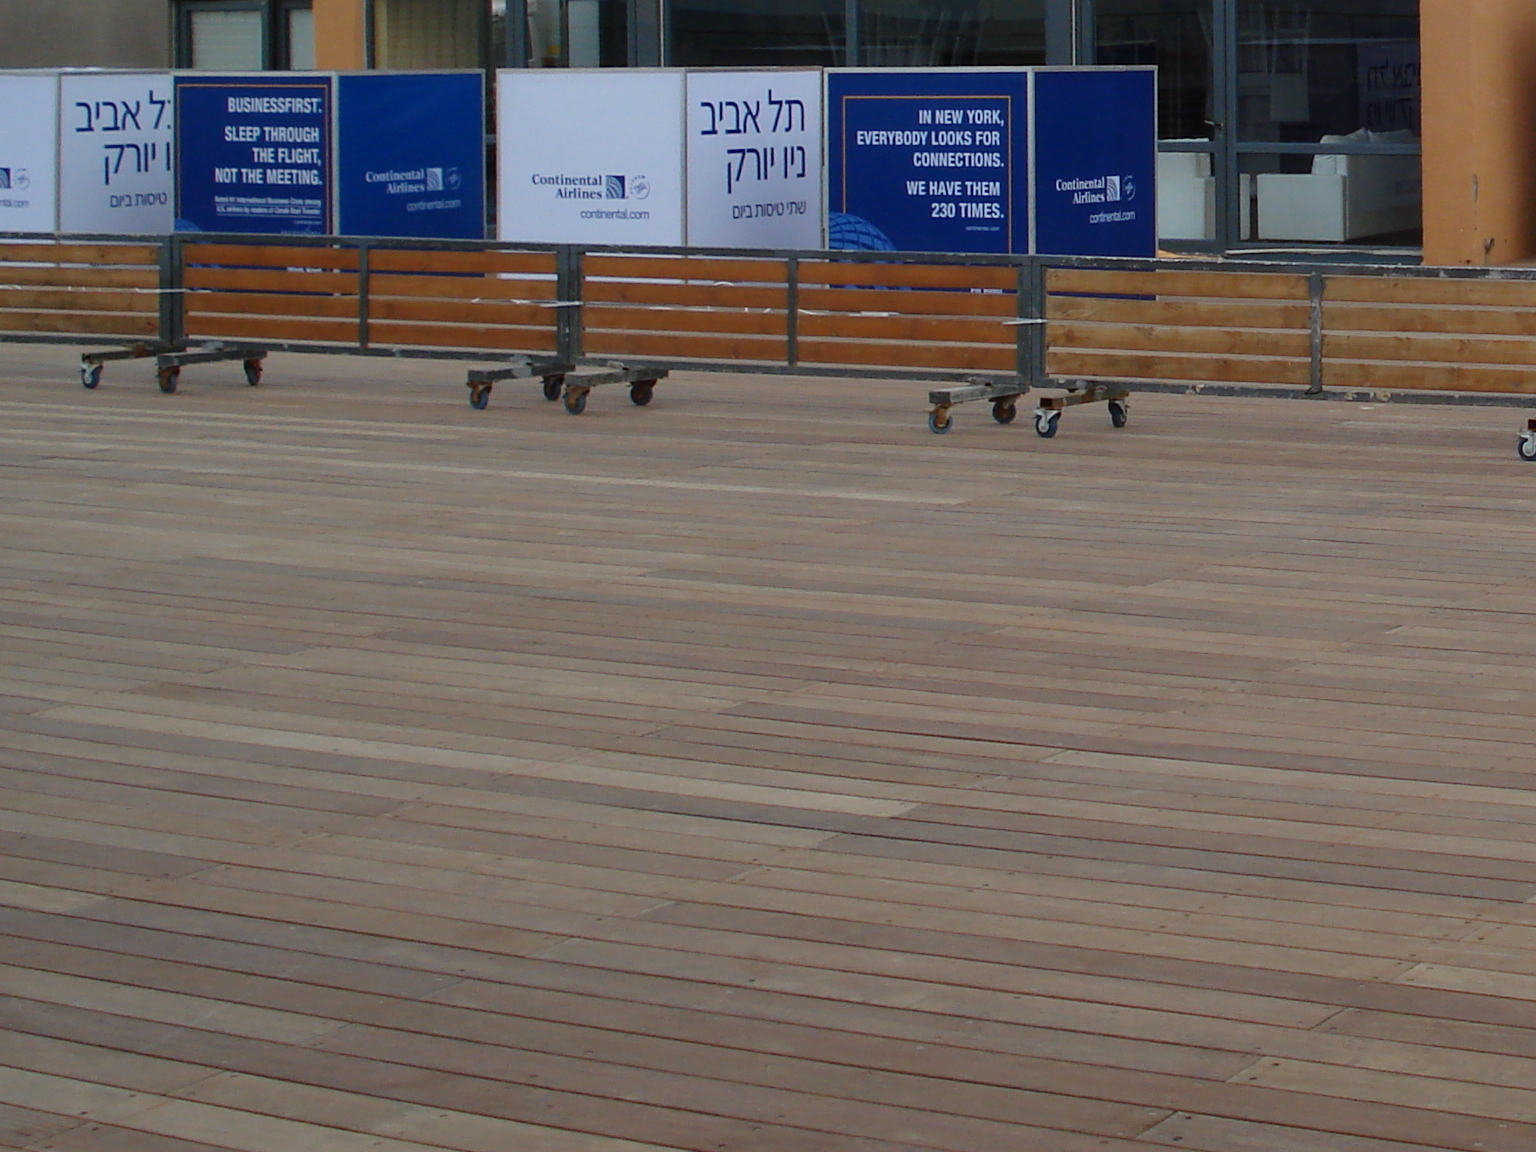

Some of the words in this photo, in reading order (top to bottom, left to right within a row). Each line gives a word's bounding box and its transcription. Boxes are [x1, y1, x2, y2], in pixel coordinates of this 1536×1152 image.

[75, 100, 141, 133] אביב
[700, 100, 761, 135] אביב
[768, 89, 805, 134] תל
[918, 109, 932, 125] IN
[935, 109, 964, 125] NEW
[966, 109, 1005, 127] YORK,
[224, 126, 261, 142] SLEEP
[263, 126, 320, 143] THROUGH
[856, 131, 928, 146] EVERYBODY
[931, 131, 973, 146] LOOKS
[975, 131, 1001, 146] FOR
[104, 141, 156, 186] יורק
[252, 147, 276, 164] THE
[277, 148, 322, 167] FLIGHT,
[783, 145, 806, 179] ניו
[912, 152, 1005, 168] CONNECTIONS.
[215, 167, 238, 184] NOT
[240, 168, 264, 184] THE
[265, 169, 323, 186] MEETING.
[364, 168, 425, 183] Continental
[726, 147, 775, 195] יורק
[531, 173, 603, 186] Continental
[1055, 176, 1105, 192] Continental
[386, 182, 426, 195] Airlines
[555, 186, 603, 199] Airlines
[906, 180, 927, 196] WE
[929, 180, 962, 196] HAVE
[964, 181, 1001, 196] THEM
[1072, 191, 1105, 205] Airlines
[580, 209, 650, 220] continental.com
[731, 204, 753, 220] ביום
[754, 201, 785, 218] טיסות
[786, 200, 807, 216] שתי
[931, 202, 956, 218] 230
[958, 202, 1005, 219] TIMES.
[1089, 210, 1136, 224] continental.com
